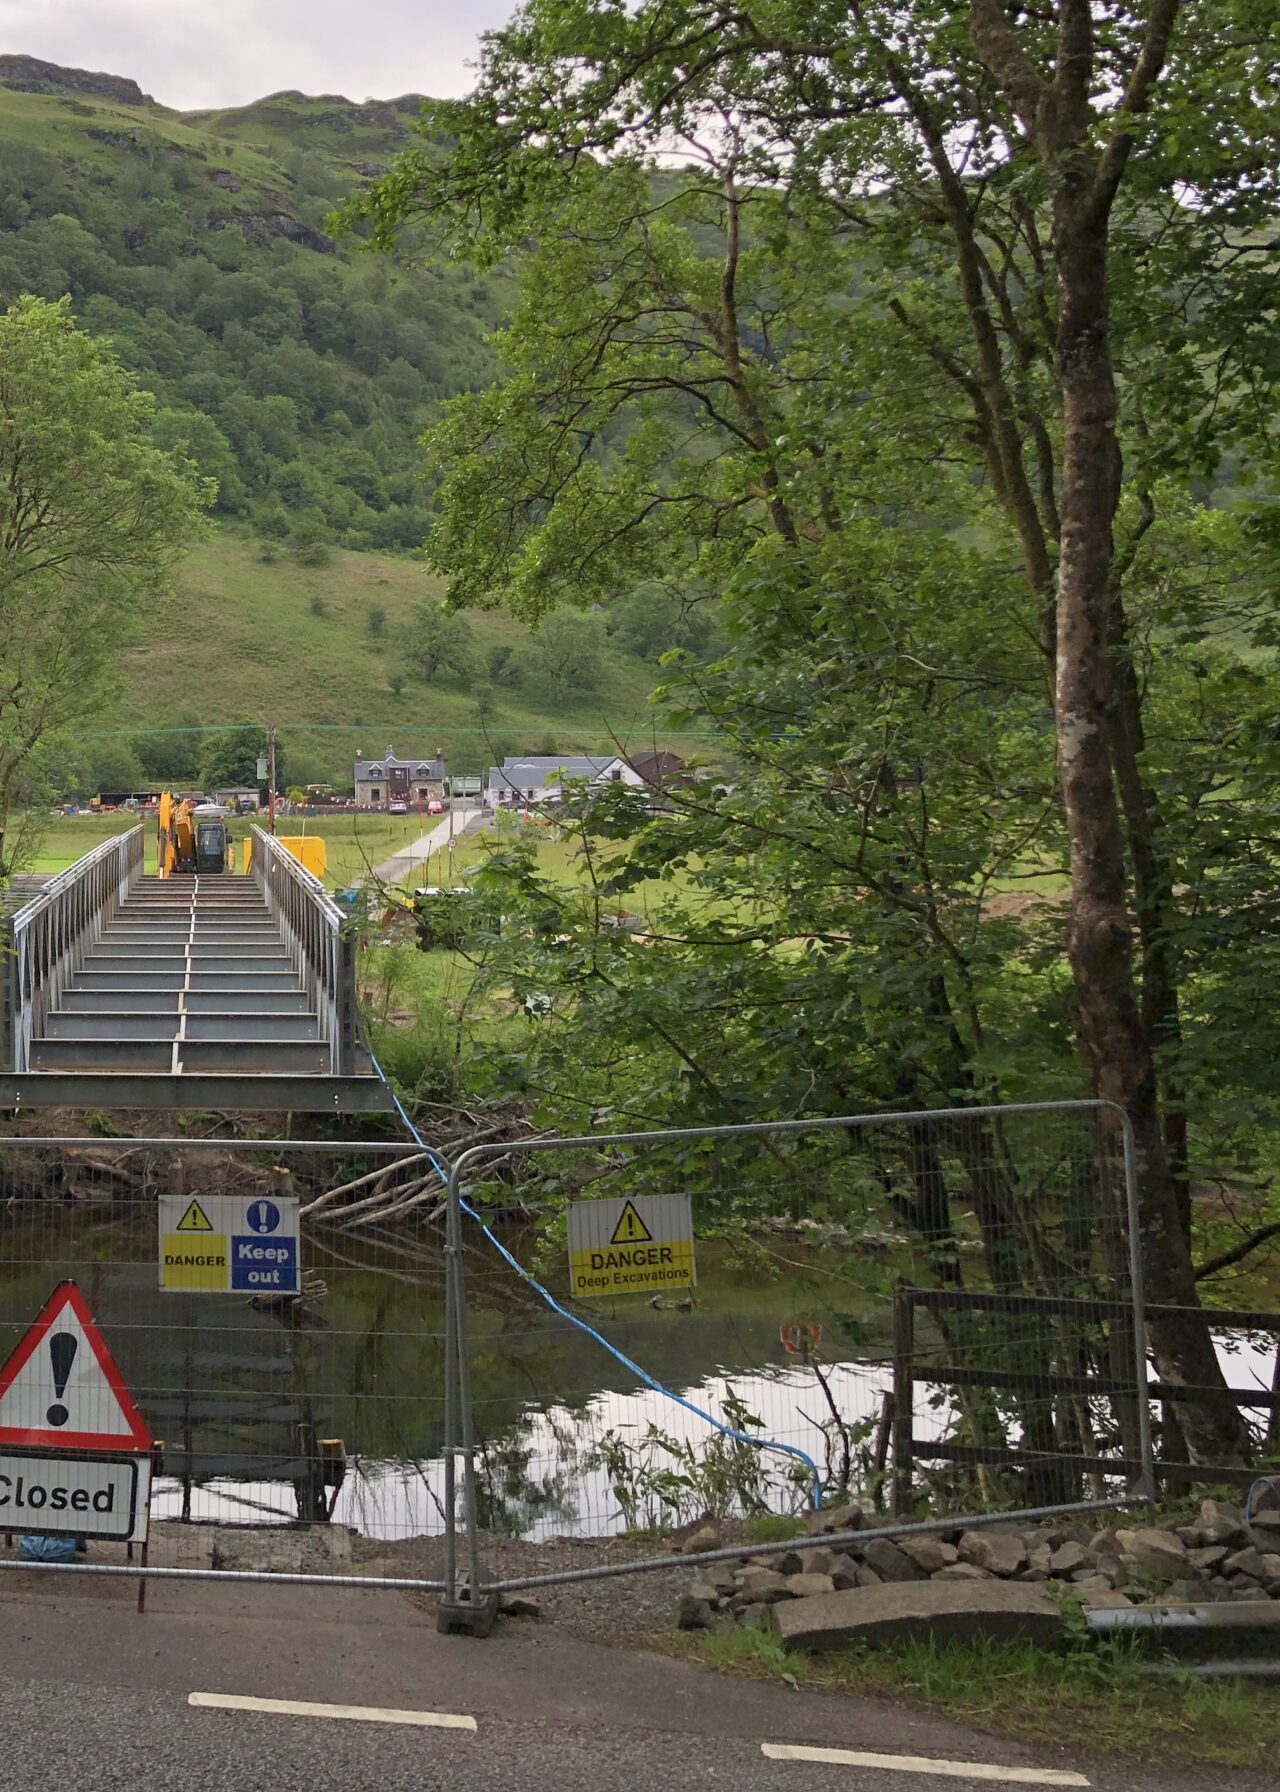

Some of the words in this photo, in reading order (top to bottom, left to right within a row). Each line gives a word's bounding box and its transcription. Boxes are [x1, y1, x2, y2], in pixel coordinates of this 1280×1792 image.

[165, 1255, 225, 1266] DANGER
[238, 1244, 289, 1263] Keep
[591, 1247, 673, 1271] DANGER
[248, 1270, 280, 1283] out
[577, 1276, 609, 1288] Deep
[614, 1268, 689, 1286] Excavations
